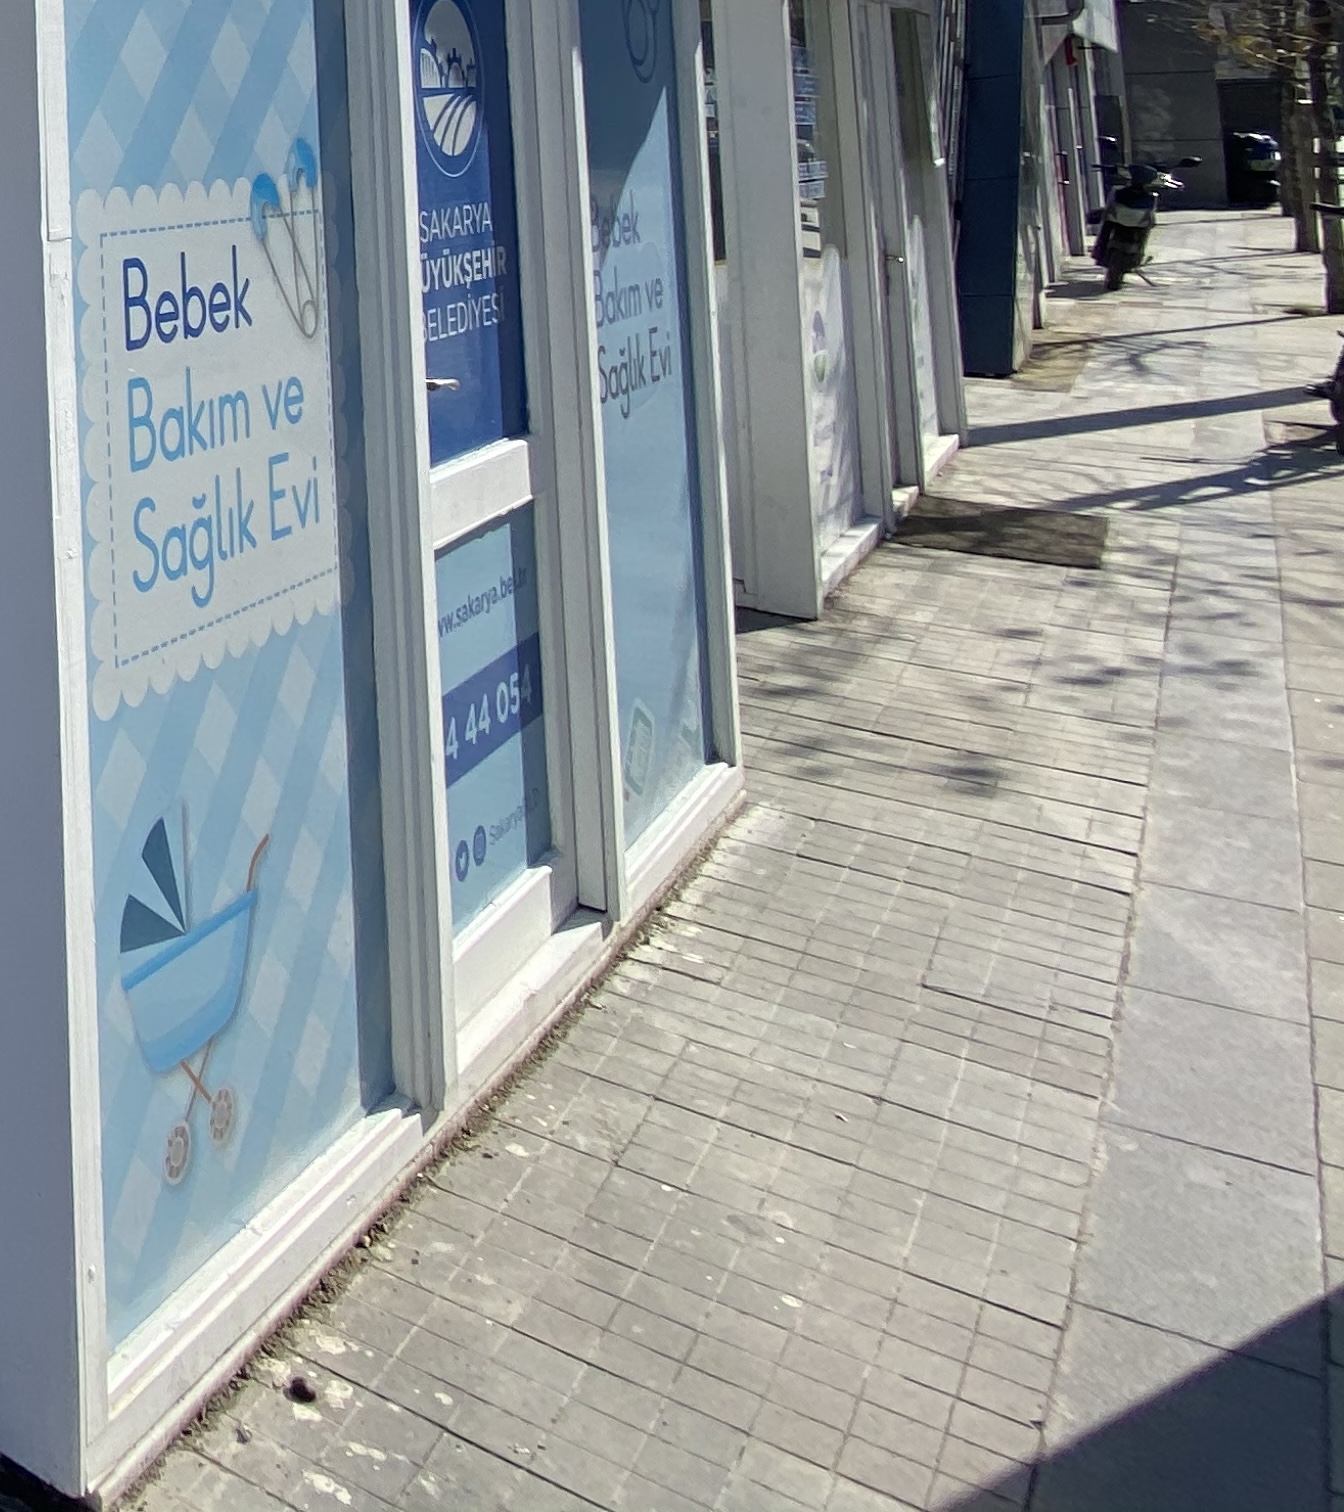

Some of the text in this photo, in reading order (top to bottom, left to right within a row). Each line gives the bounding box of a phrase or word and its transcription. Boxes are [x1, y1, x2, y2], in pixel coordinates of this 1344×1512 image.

[419, 202, 493, 243] SAKARYA
[420, 240, 507, 294] ÜYÜKŞEHİR
[123, 244, 253, 351] Bebek
[645, 277, 663, 311] ve
[598, 326, 672, 419] Sağlık Evi
[127, 367, 304, 473] Bakım ve
[131, 452, 322, 609] Sağlık Evi
